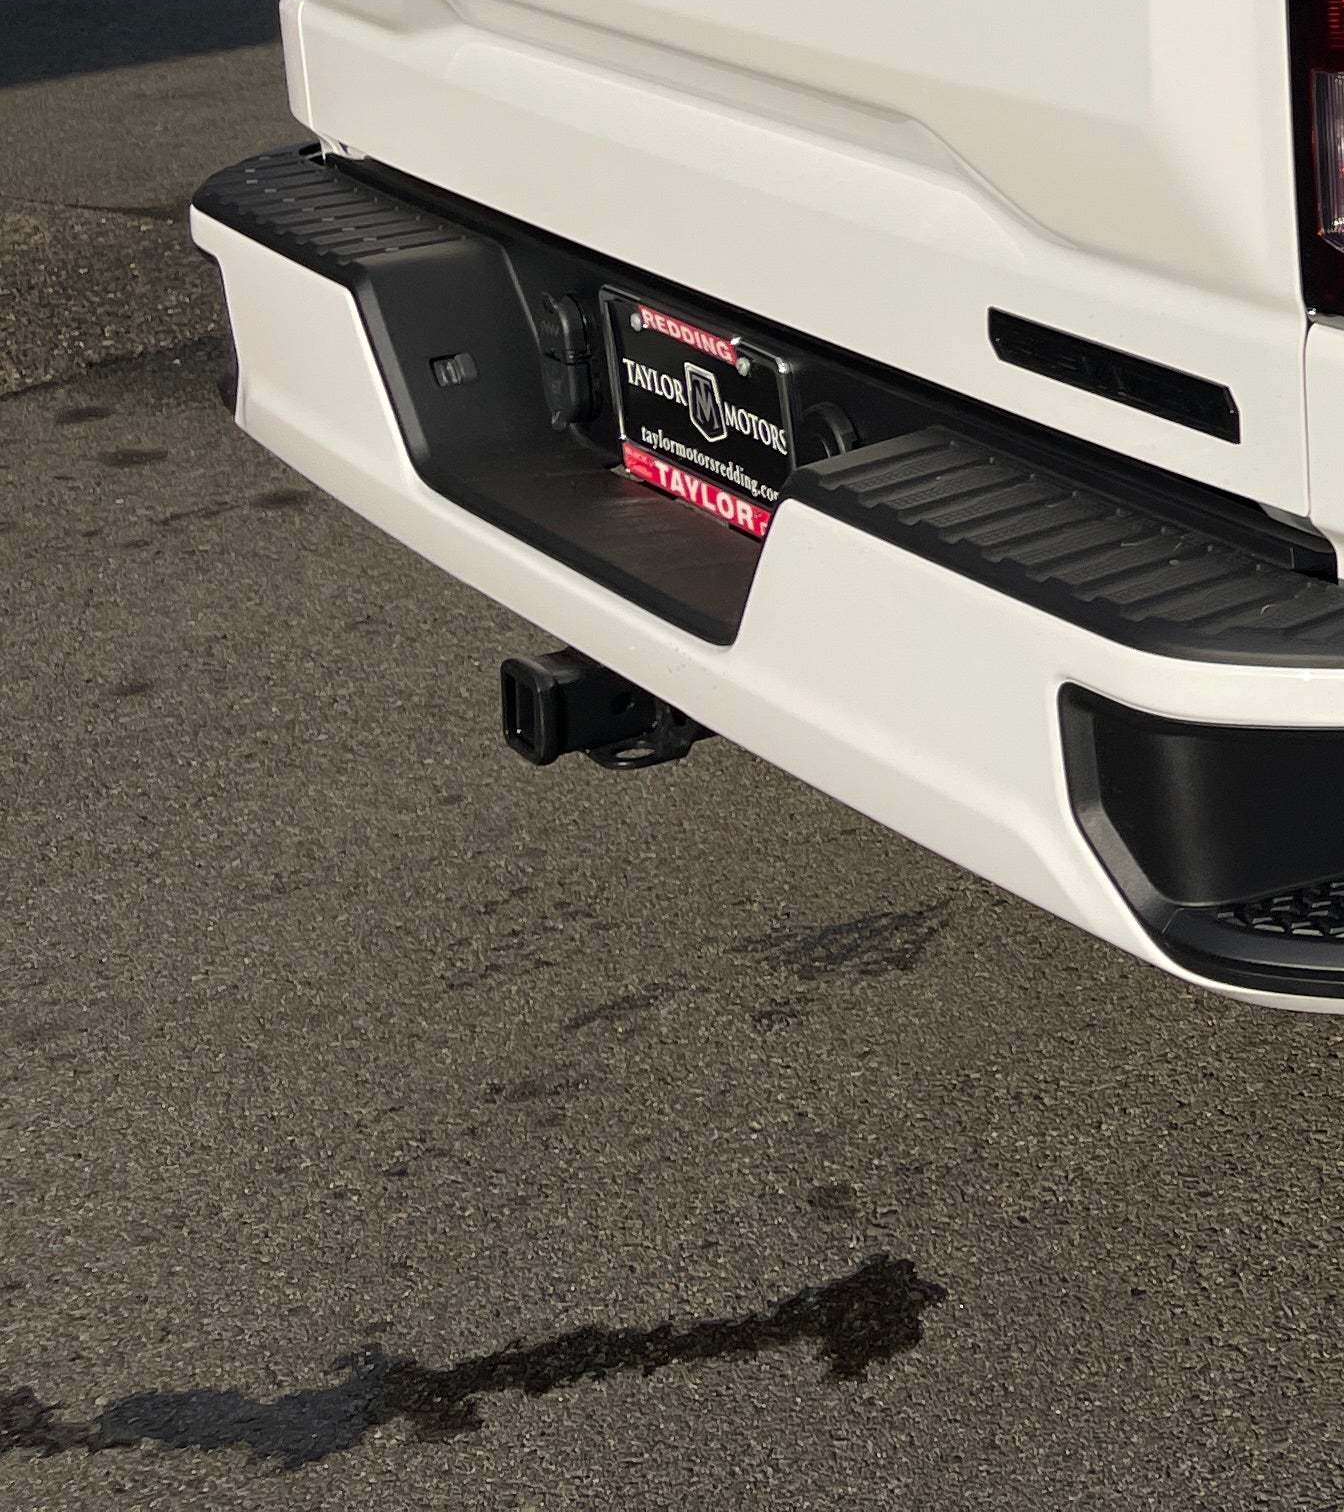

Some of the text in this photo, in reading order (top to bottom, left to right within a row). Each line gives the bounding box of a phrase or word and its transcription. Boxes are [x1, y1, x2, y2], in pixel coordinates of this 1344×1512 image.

[641, 309, 734, 363] REDDING
[622, 357, 689, 406] TAYLOR
[723, 400, 788, 456] MOTORS
[653, 460, 755, 530] TAYLOR
